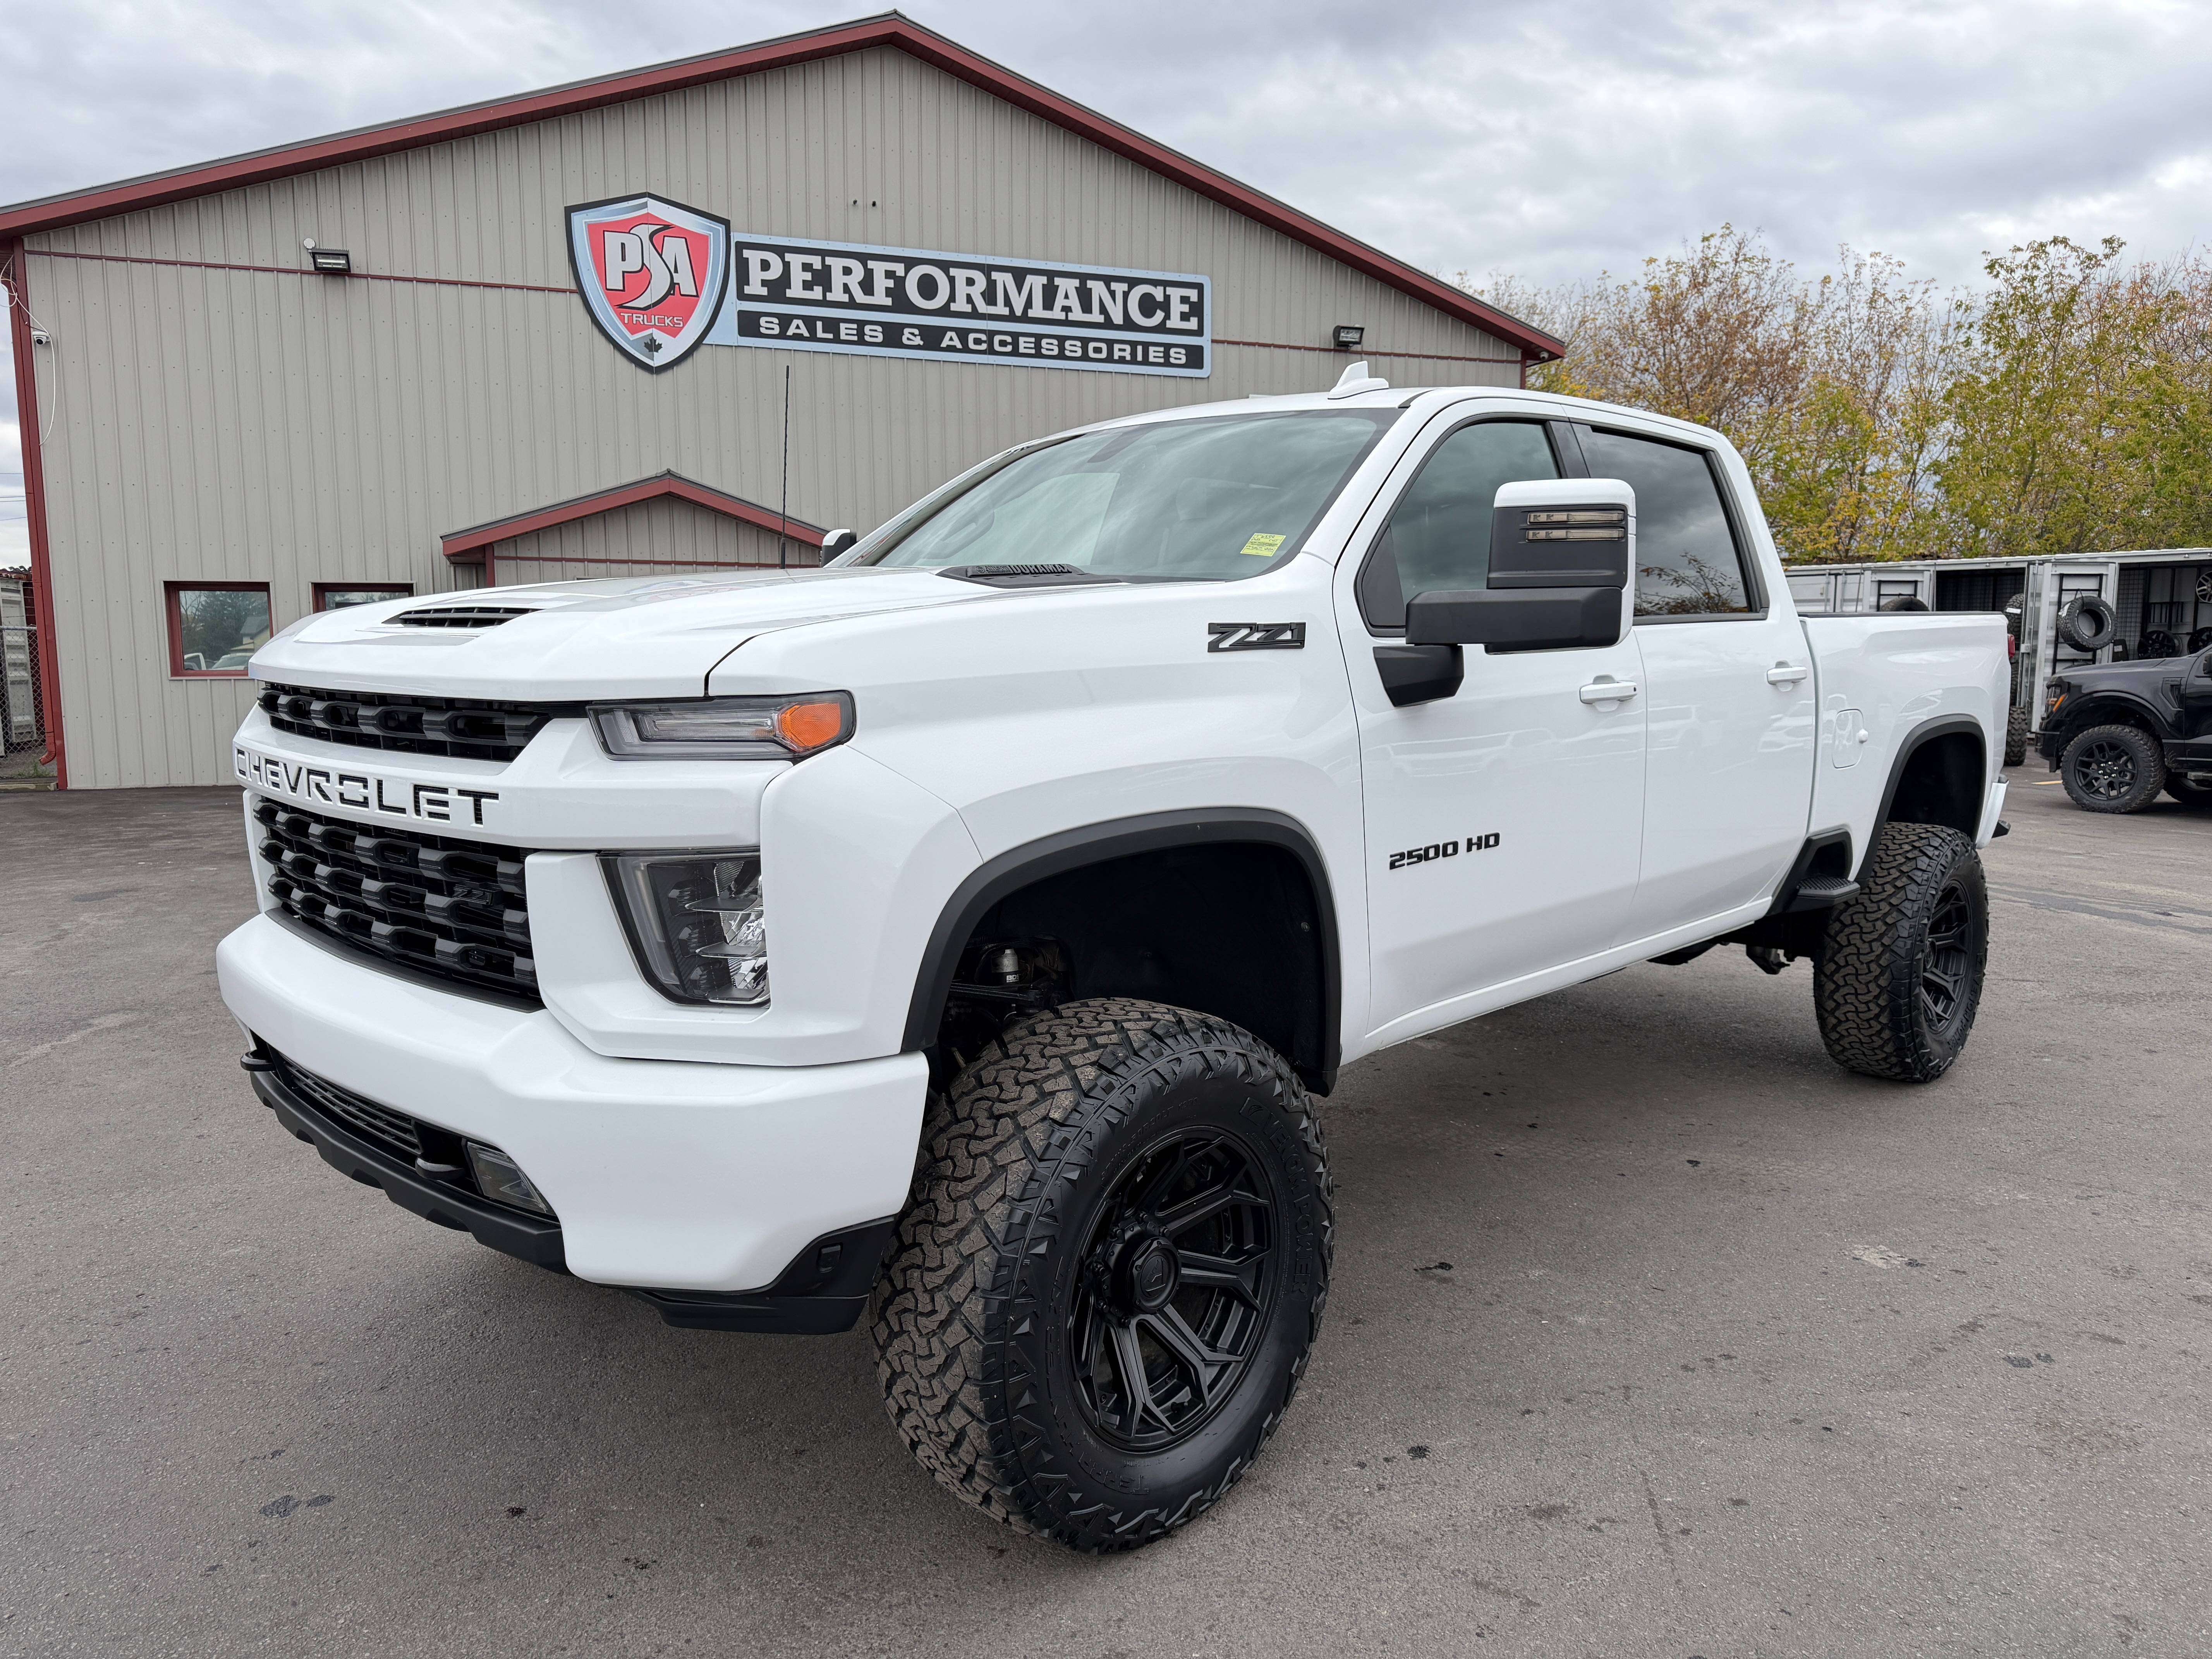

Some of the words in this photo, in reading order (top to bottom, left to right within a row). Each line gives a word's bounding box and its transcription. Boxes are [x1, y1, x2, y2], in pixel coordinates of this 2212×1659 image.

[603, 223, 699, 311] PSA
[742, 249, 1199, 330] PERFORMANCE
[620, 313, 684, 328] TRUCKS
[759, 316, 883, 343] SALES
[902, 328, 924, 345] &
[940, 331, 1187, 364] ACCESSORIES
[1008, 564, 1072, 574] DURAMAX
[1207, 622, 1306, 652] Z71
[235, 749, 500, 828] CHEVROLET
[1389, 841, 1458, 870] 2500
[1467, 832, 1500, 852] HD
[1263, 1113, 1307, 1195] VENOM
[1292, 1193, 1314, 1295] POWER
